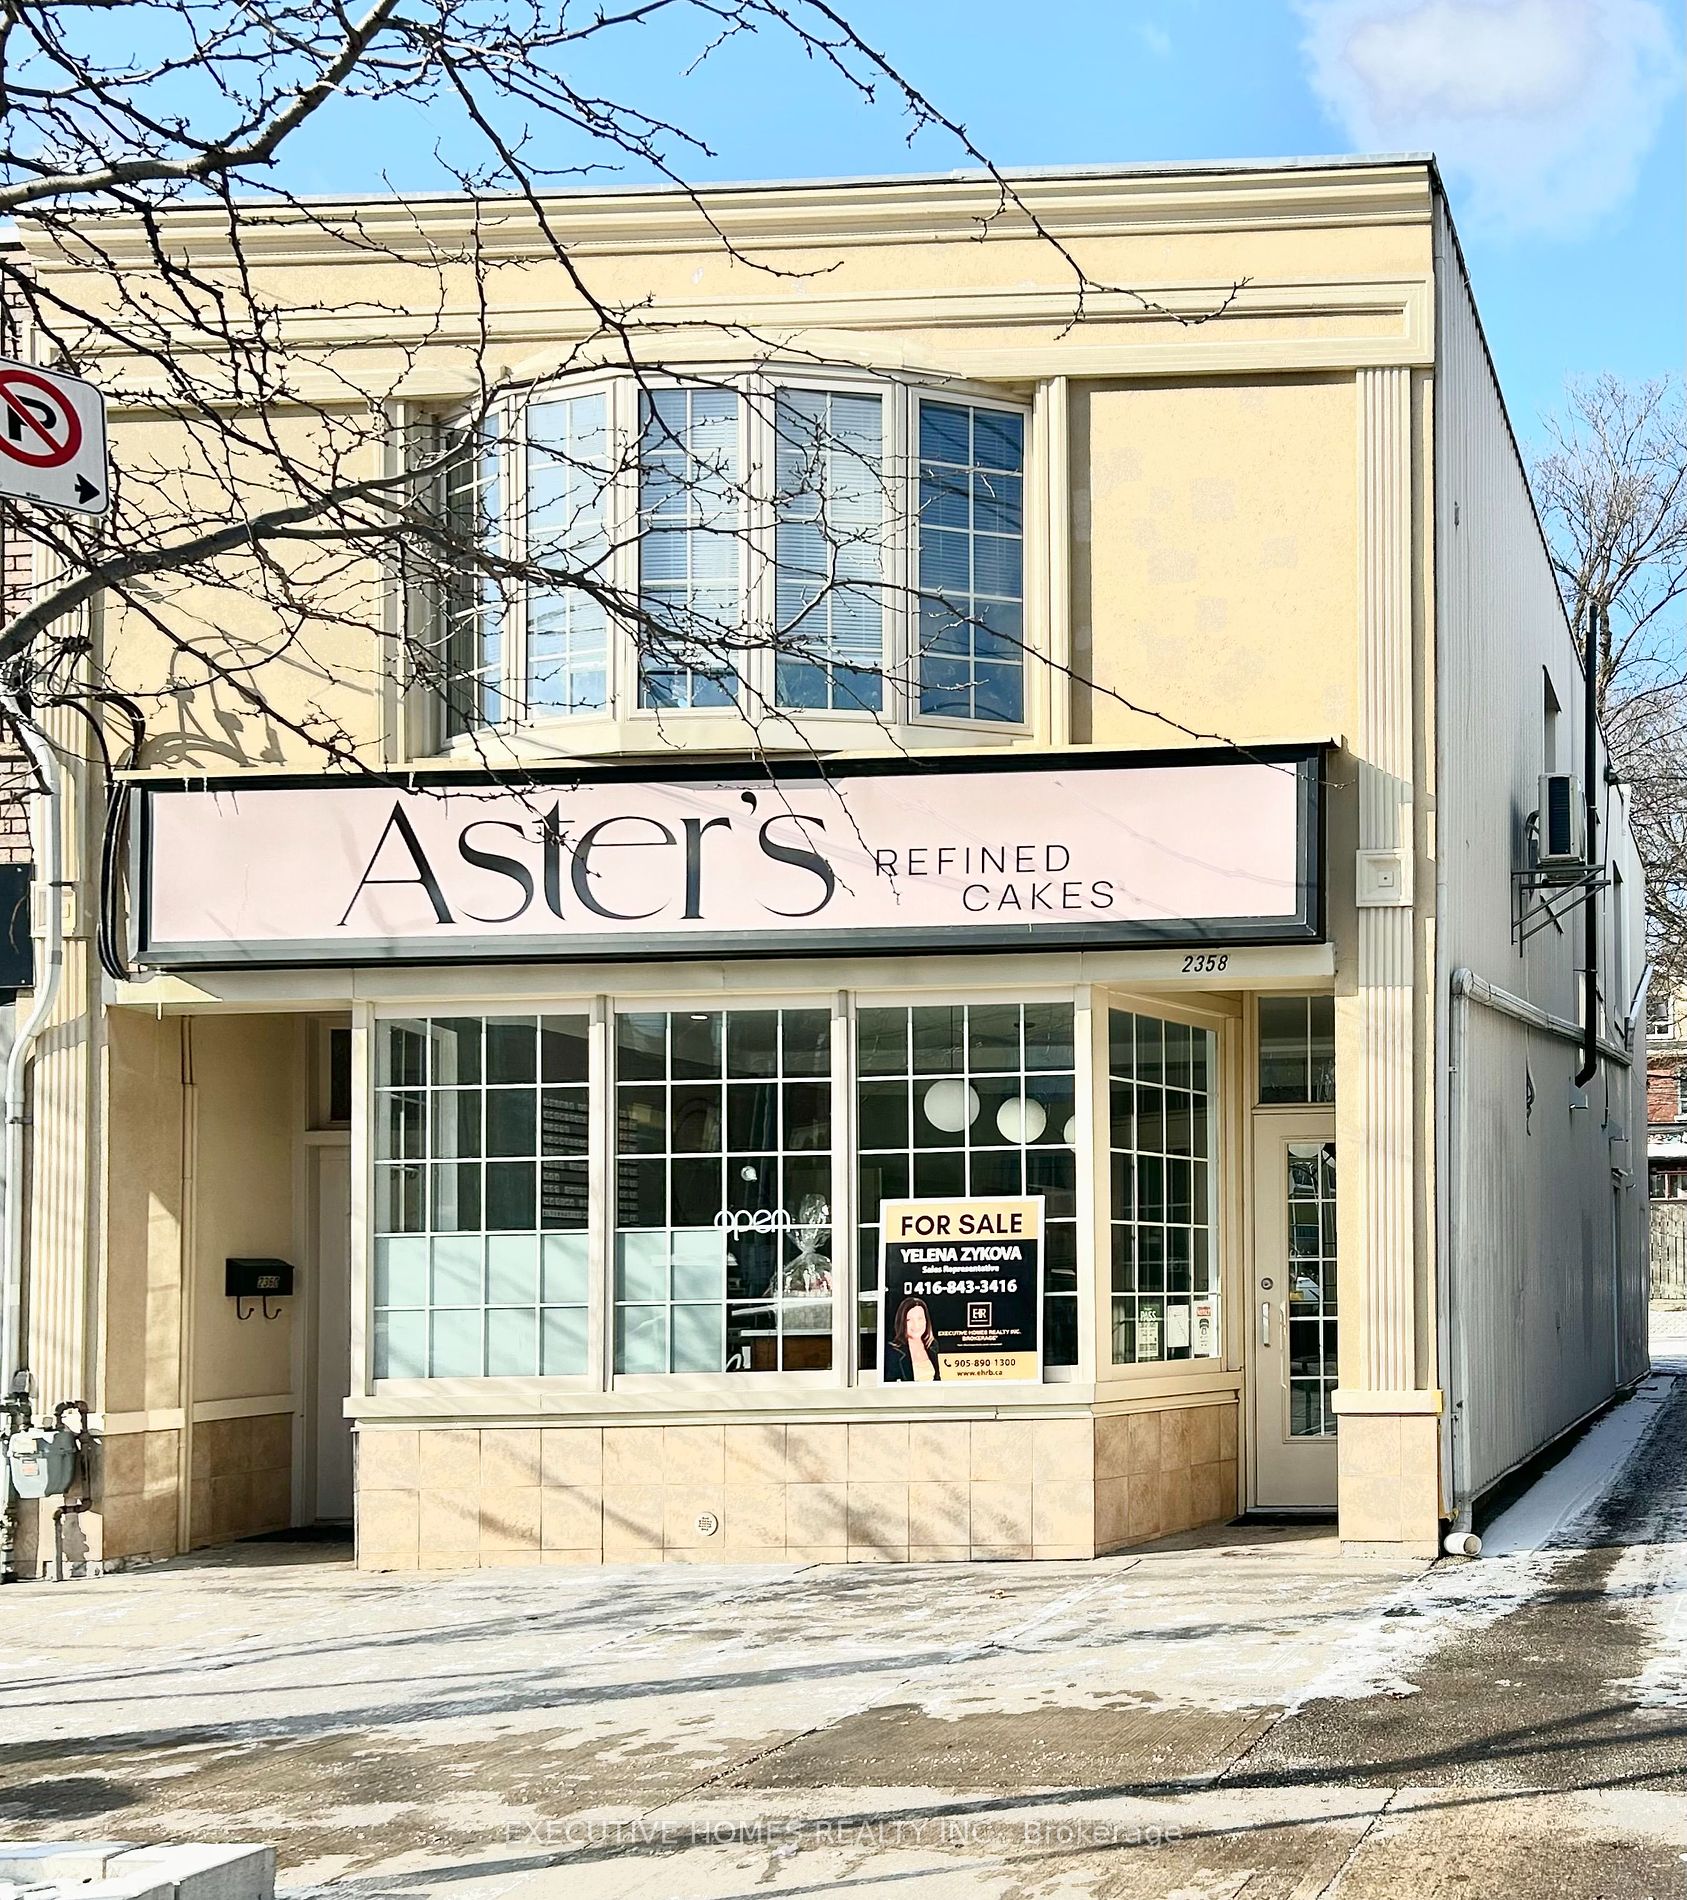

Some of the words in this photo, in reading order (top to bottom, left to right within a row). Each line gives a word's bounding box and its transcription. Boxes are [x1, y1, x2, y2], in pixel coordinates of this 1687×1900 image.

[337, 791, 836, 926] Aster's
[876, 845, 1070, 877] REFINED
[962, 881, 1114, 911] CAKES
[1182, 955, 1228, 973] 2358
[713, 1209, 791, 1241] open
[901, 1215, 950, 1236] FOR
[959, 1213, 1022, 1234] SALE
[901, 1247, 958, 1263] YELENA
[960, 1246, 1022, 1261] ZYKOVA
[922, 1265, 942, 1273] Sales
[943, 1264, 999, 1274] Representative
[914, 1279, 1017, 1294] 416-843-3416
[1140, 1310, 1157, 1321] PASS
[995, 1358, 1016, 1367] 1300
[957, 1369, 1003, 1377] www.ehrb.ca
